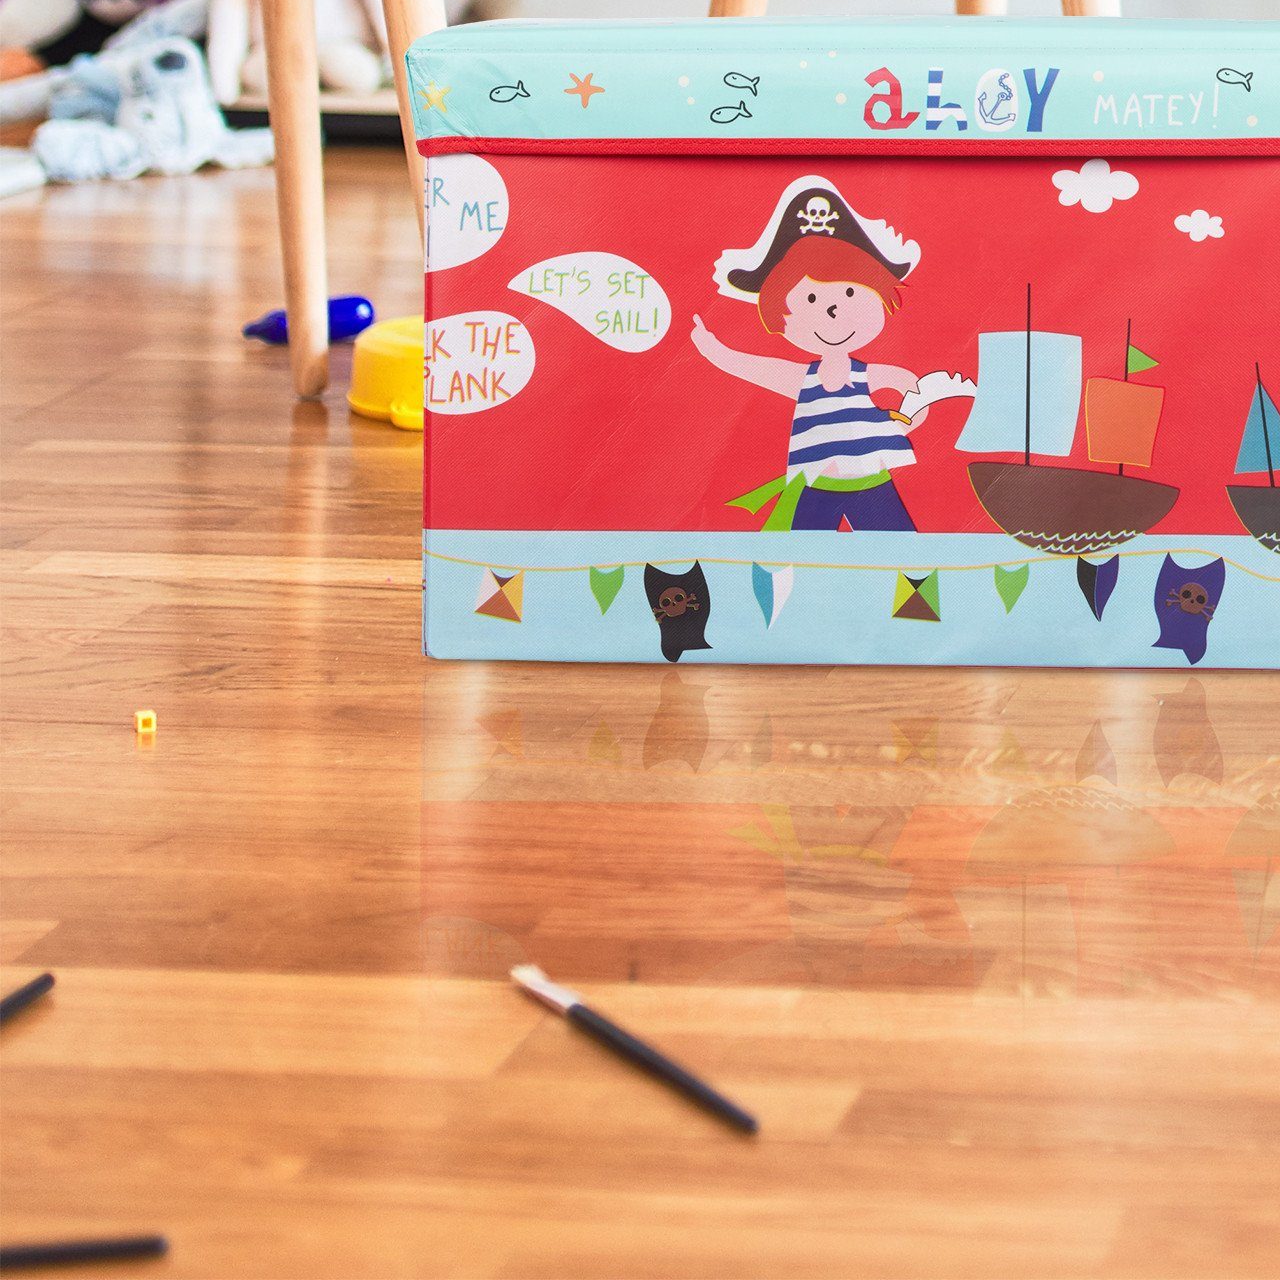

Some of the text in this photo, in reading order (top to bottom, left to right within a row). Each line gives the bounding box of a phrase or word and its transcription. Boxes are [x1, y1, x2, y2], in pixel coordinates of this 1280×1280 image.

[1093, 81, 1219, 130] MATEY!
[460, 201, 504, 233] ME
[528, 265, 651, 299] LET'S SET
[594, 306, 659, 338] SAIL!
[464, 321, 522, 362] THE
